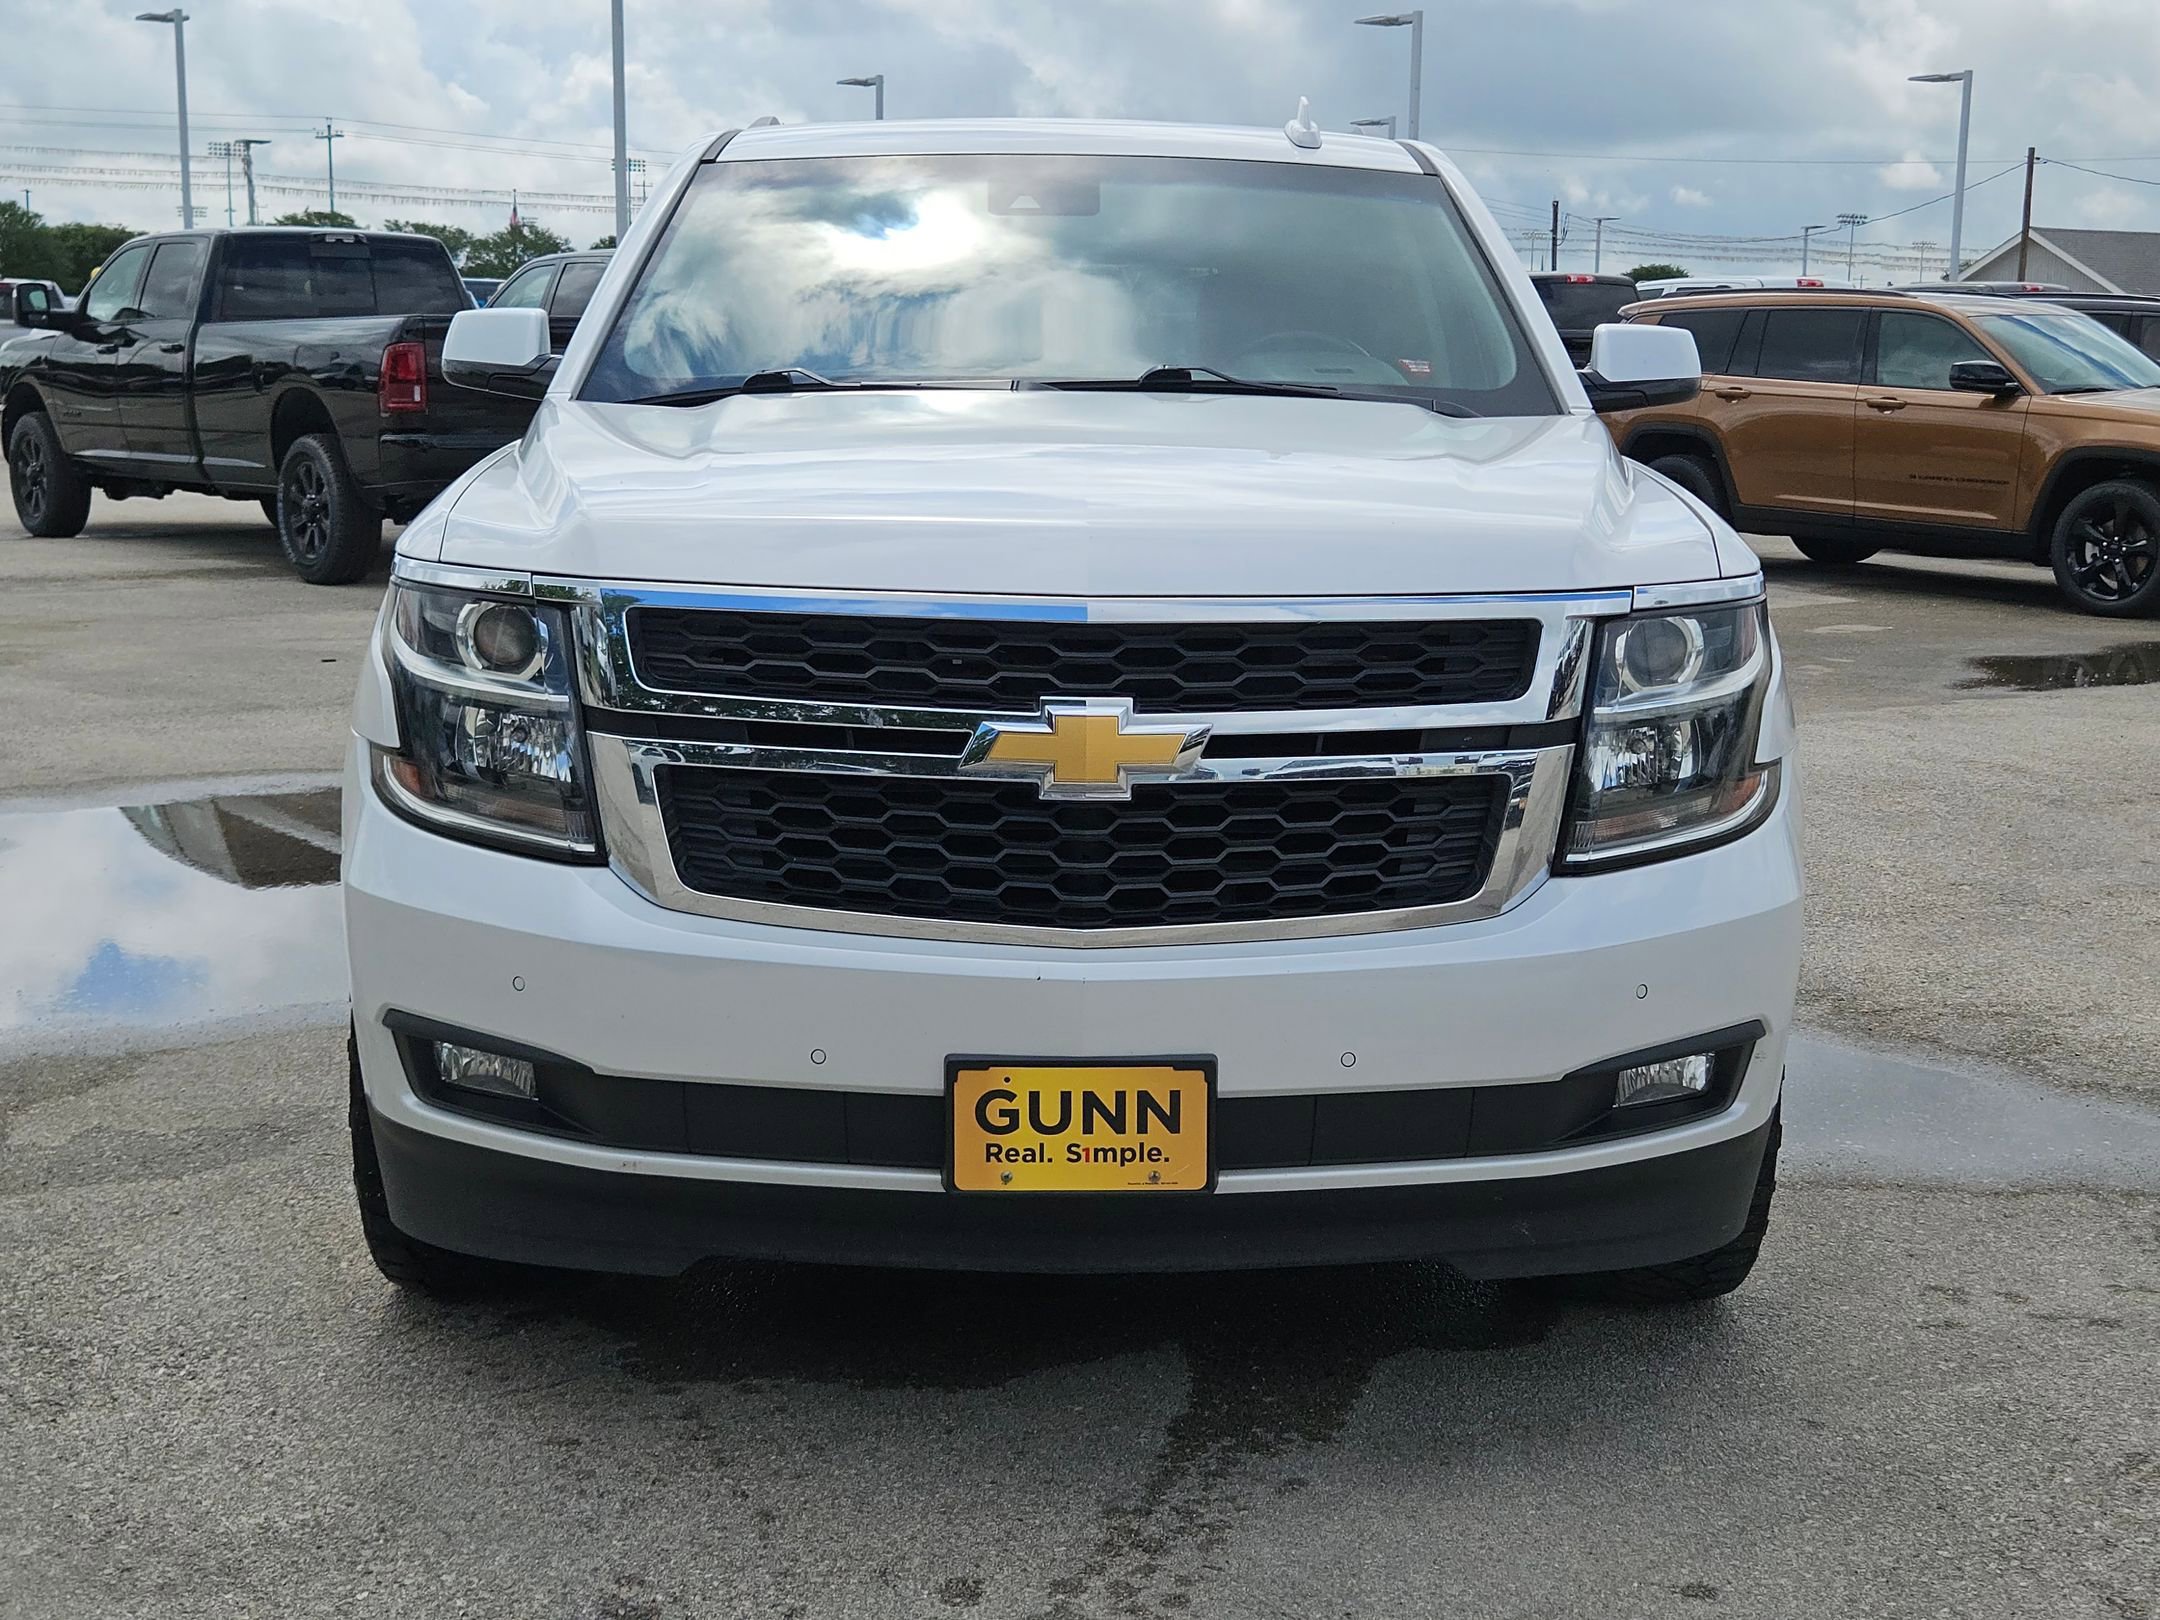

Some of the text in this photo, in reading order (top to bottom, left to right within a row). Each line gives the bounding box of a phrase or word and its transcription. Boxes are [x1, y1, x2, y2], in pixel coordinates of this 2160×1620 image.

[974, 1088, 1181, 1136] GUNN
[985, 1141, 1170, 1167] Real. S1mple.
